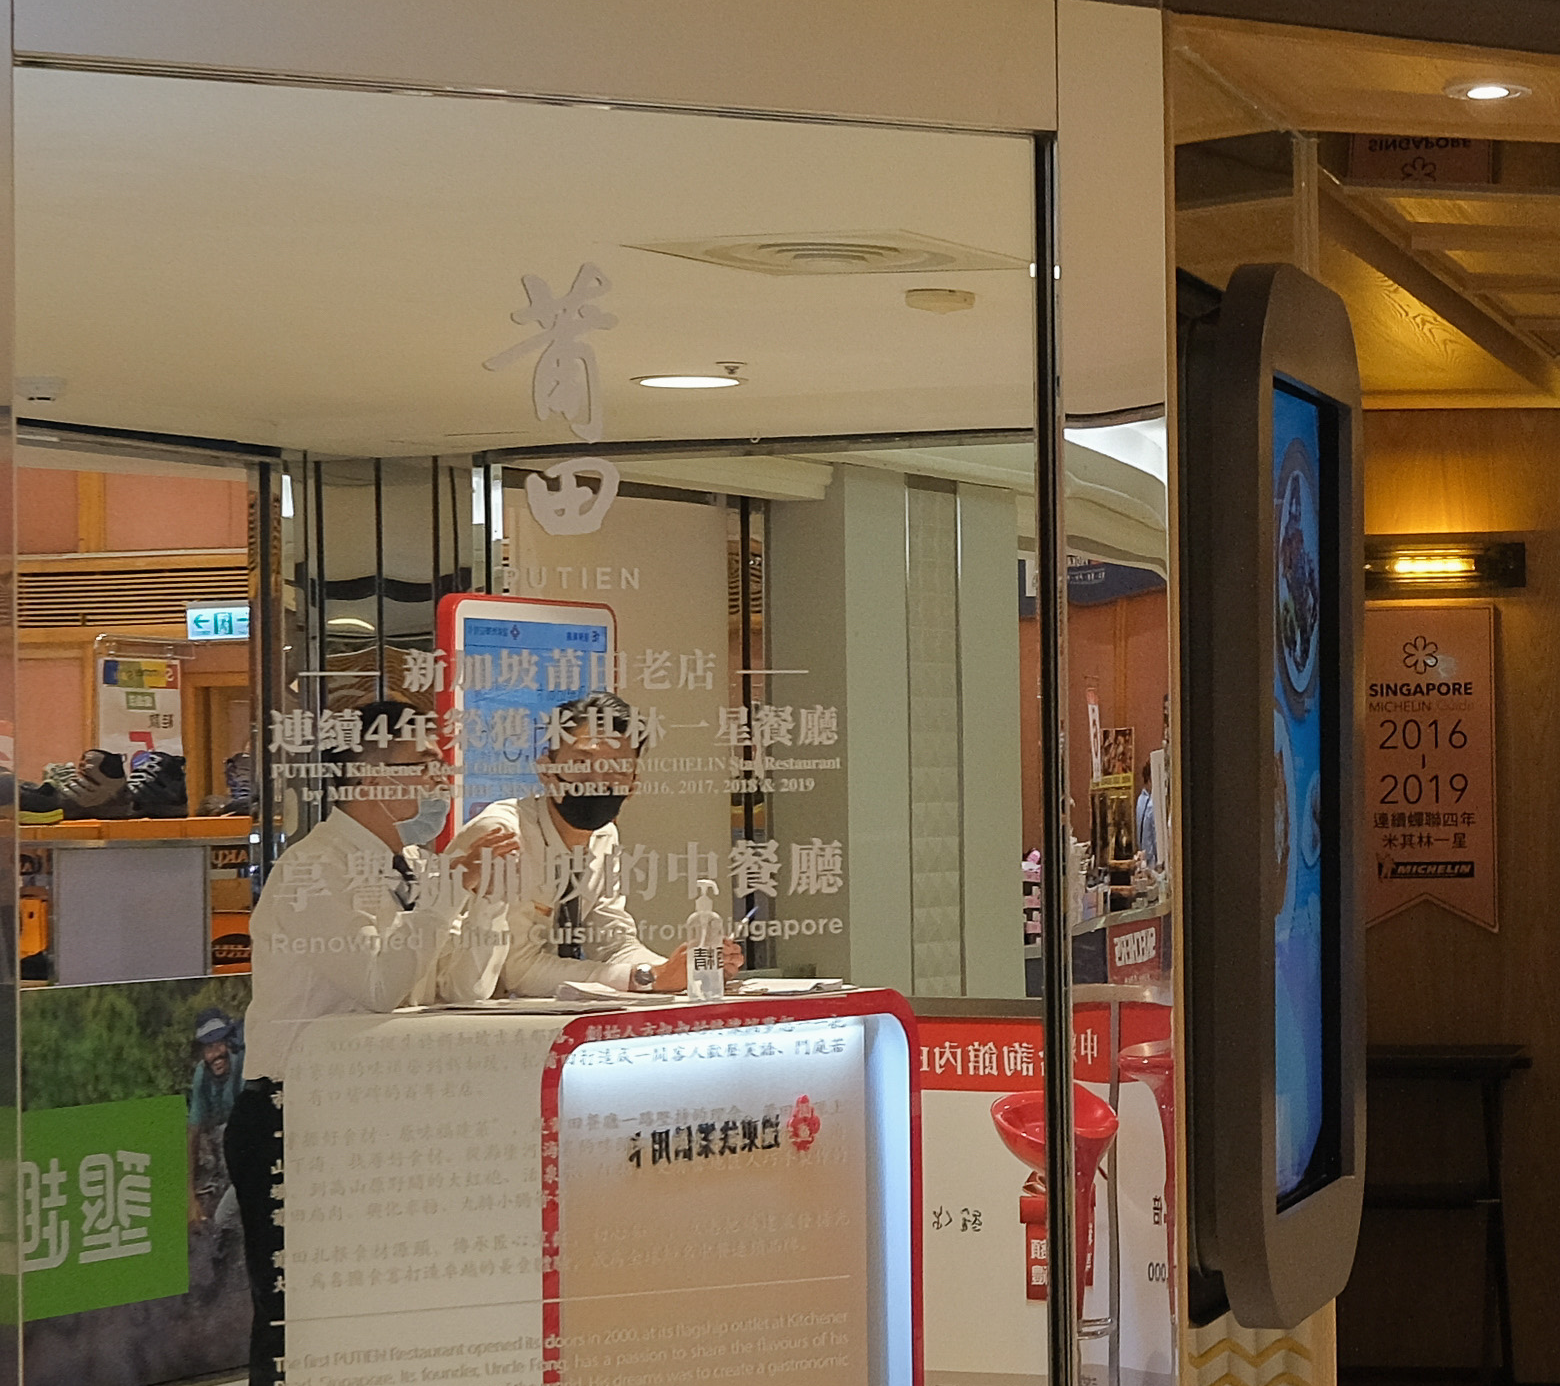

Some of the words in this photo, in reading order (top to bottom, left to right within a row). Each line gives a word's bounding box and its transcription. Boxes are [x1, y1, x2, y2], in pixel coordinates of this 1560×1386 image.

[482, 263, 619, 535] 莆田
[503, 566, 640, 591] PUTIEN
[1369, 682, 1473, 697] SINGAPORE
[1369, 700, 1431, 713] MICHELIN
[1379, 719, 1467, 749] 2016
[271, 764, 342, 779] PUTIEN
[347, 762, 425, 777] Kitchener
[594, 758, 633, 773] ONE
[638, 757, 726, 773] MICHELIN
[765, 756, 841, 770] Restaurant
[302, 786, 324, 802] by
[327, 784, 435, 801] MICHELIN
[613, 781, 629, 795] in
[723, 779, 756, 794] 2018
[781, 777, 815, 792] 2019
[1380, 773, 1469, 804] 2019
[1382, 832, 1468, 849] 米其林一星
[1397, 864, 1472, 874] MICHELIN
[271, 928, 423, 955] Renowned
[728, 917, 844, 942] ingapore
